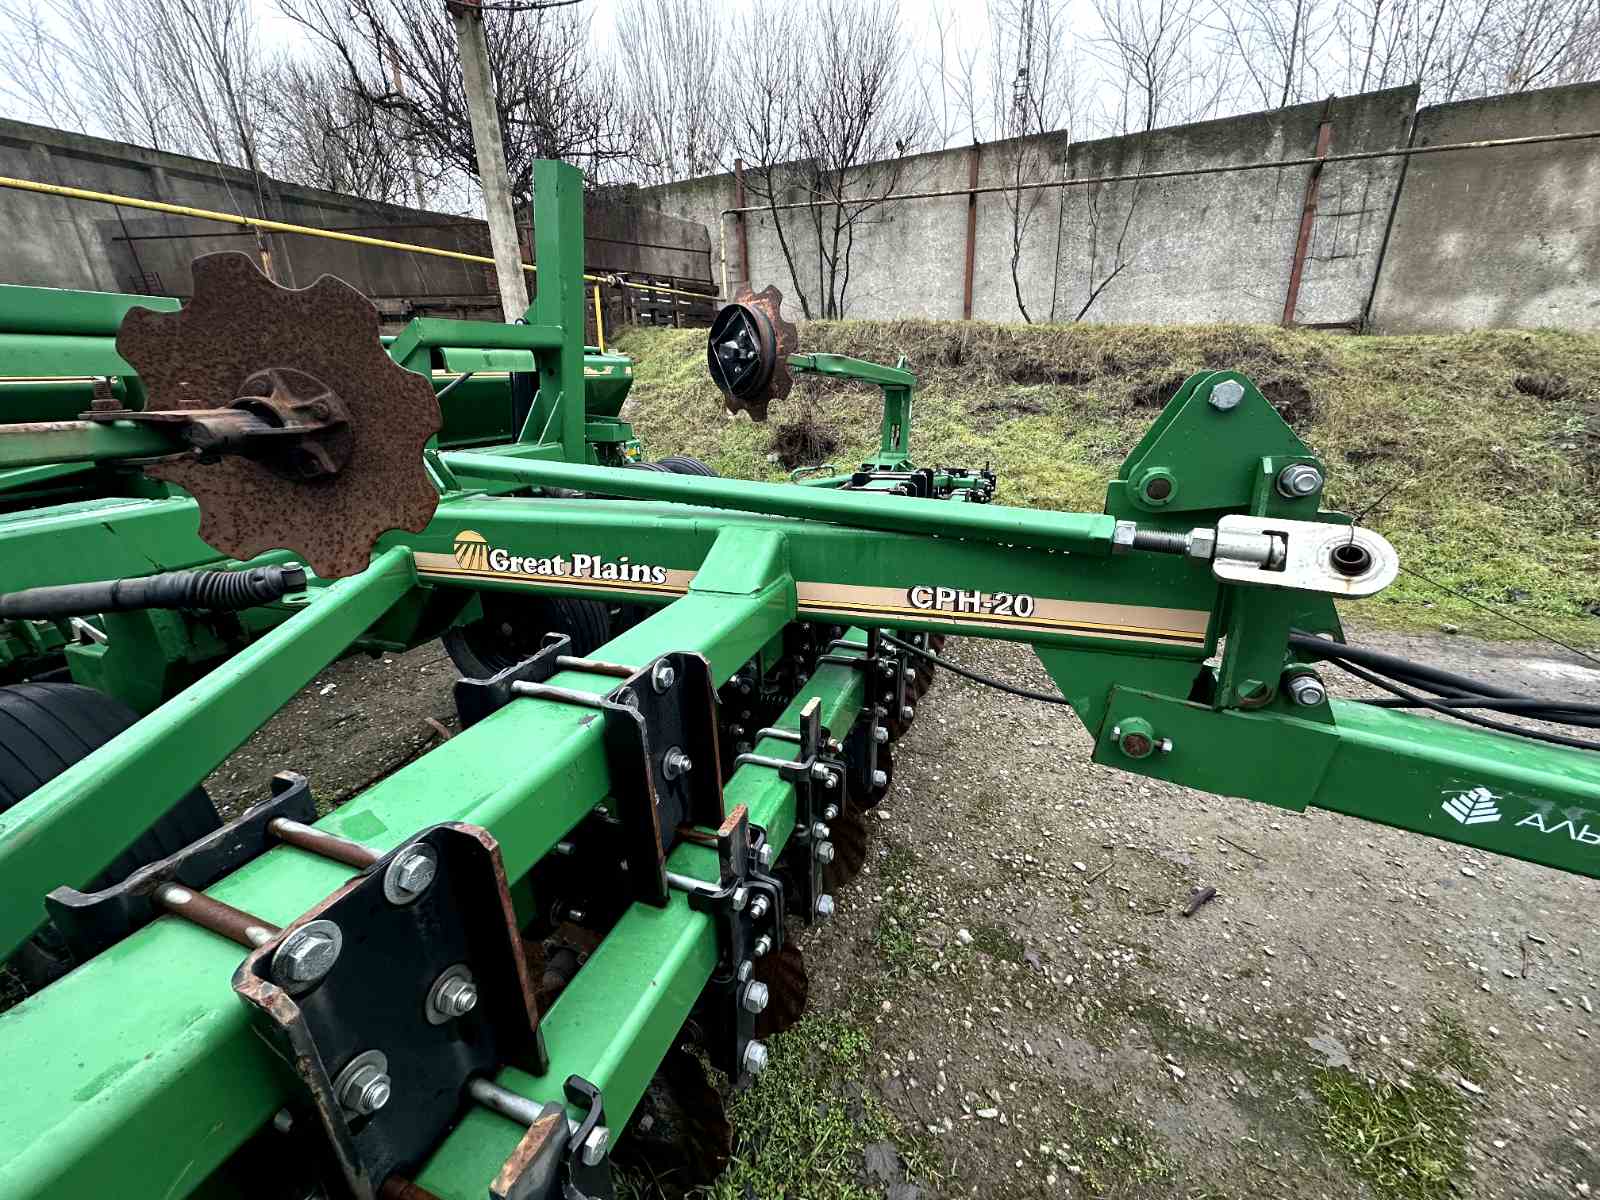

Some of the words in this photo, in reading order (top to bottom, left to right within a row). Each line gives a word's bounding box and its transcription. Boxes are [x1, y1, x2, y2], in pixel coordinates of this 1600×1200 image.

[488, 548, 565, 577] Great
[571, 553, 667, 584] Plains
[908, 585, 1034, 618] CPH-20
